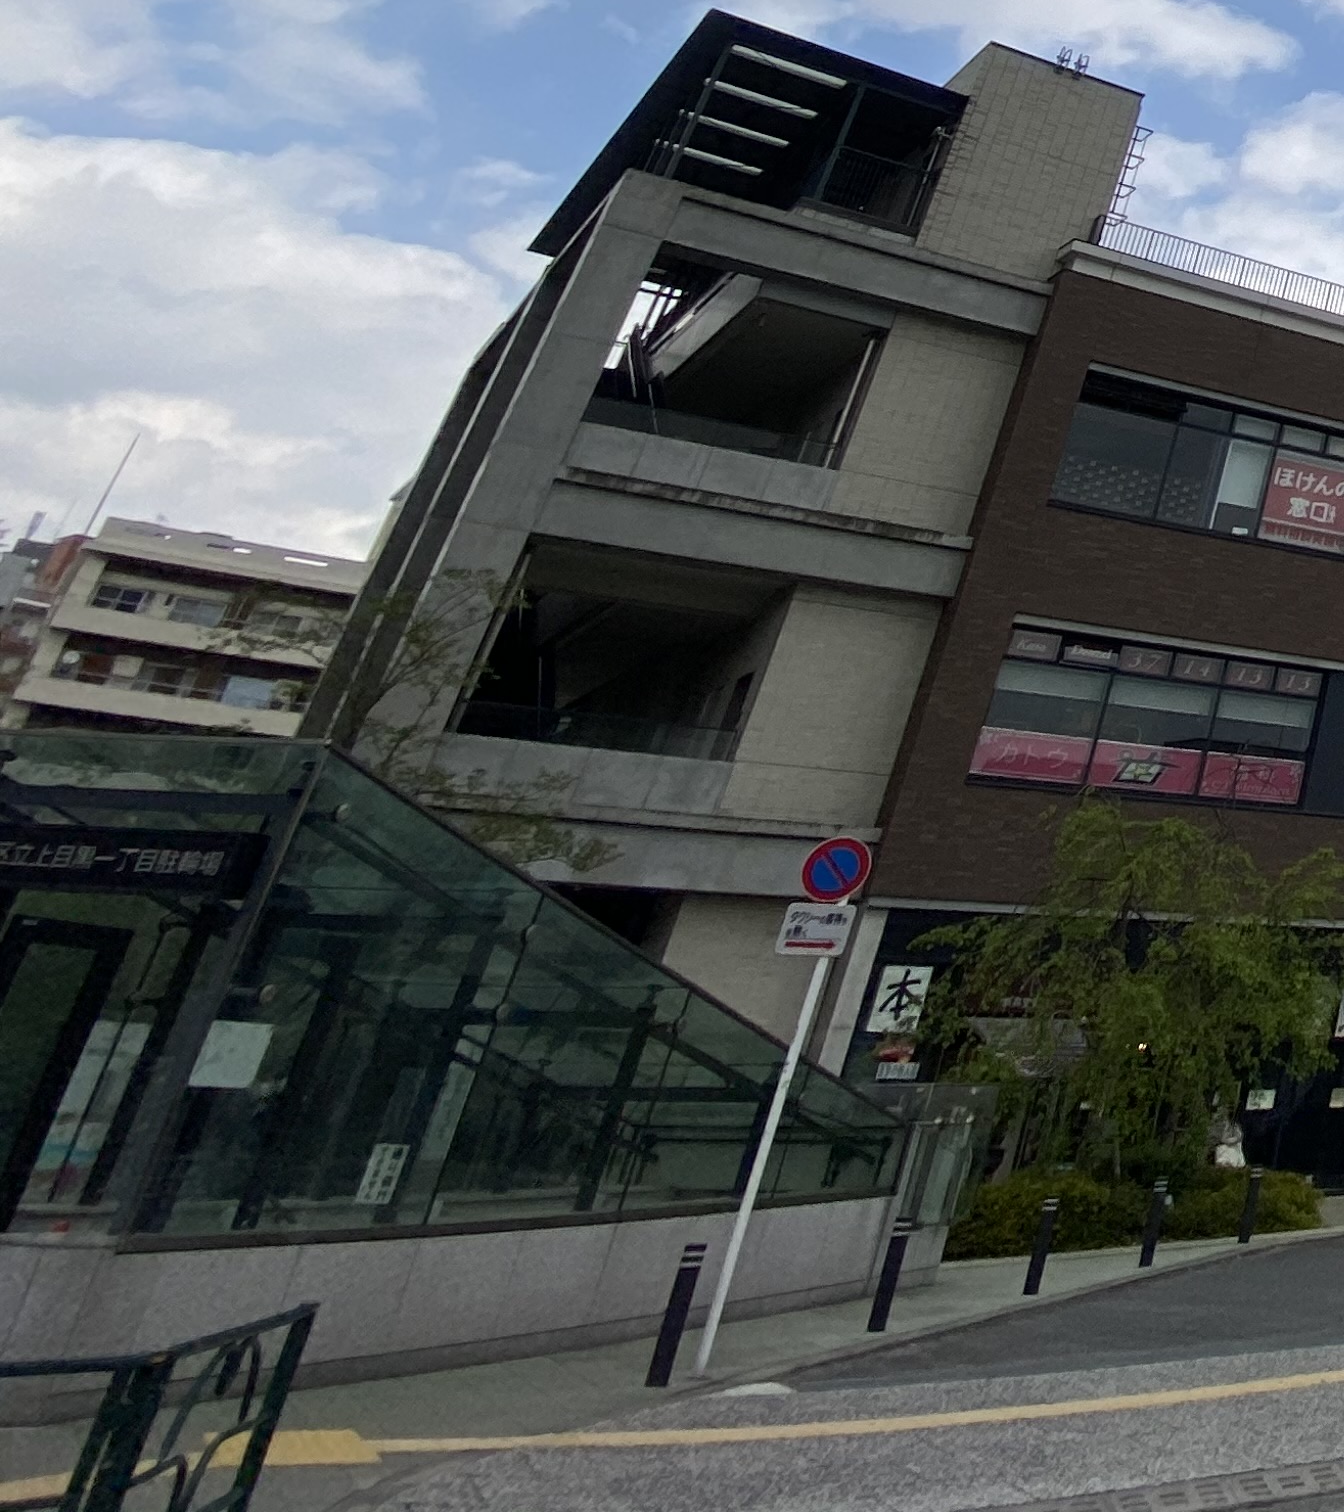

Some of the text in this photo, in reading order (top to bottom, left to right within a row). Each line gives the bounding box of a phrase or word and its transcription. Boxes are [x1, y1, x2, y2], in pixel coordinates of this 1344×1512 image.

[1286, 497, 1331, 522] 窓口
[996, 742, 1069, 769] カトウ
